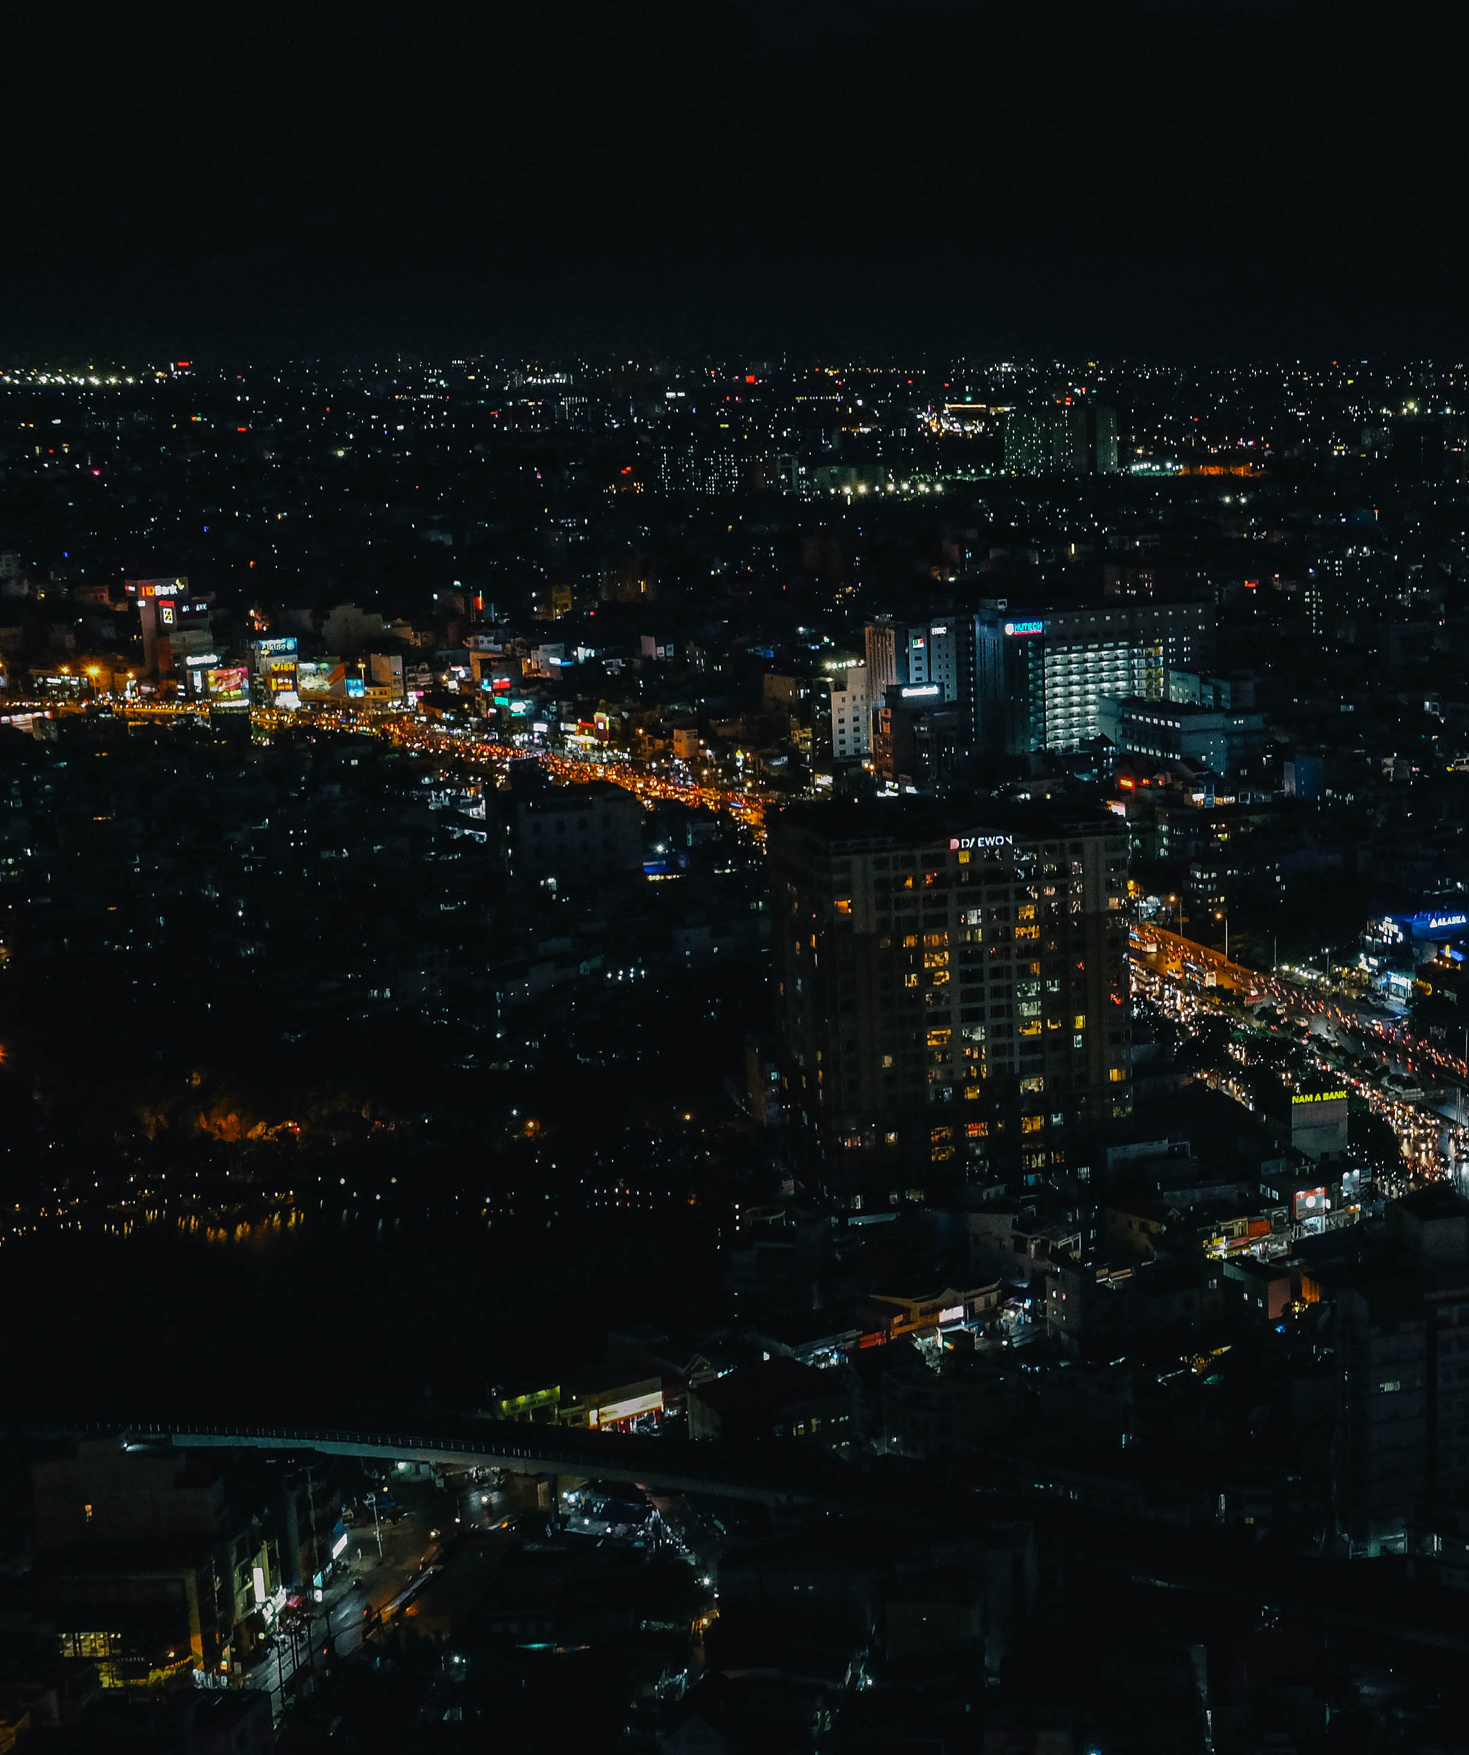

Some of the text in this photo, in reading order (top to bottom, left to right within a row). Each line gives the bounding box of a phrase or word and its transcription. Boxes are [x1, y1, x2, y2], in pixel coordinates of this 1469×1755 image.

[1014, 621, 1042, 631] HUTECH
[1292, 1090, 1347, 1104] NAM A BANK
